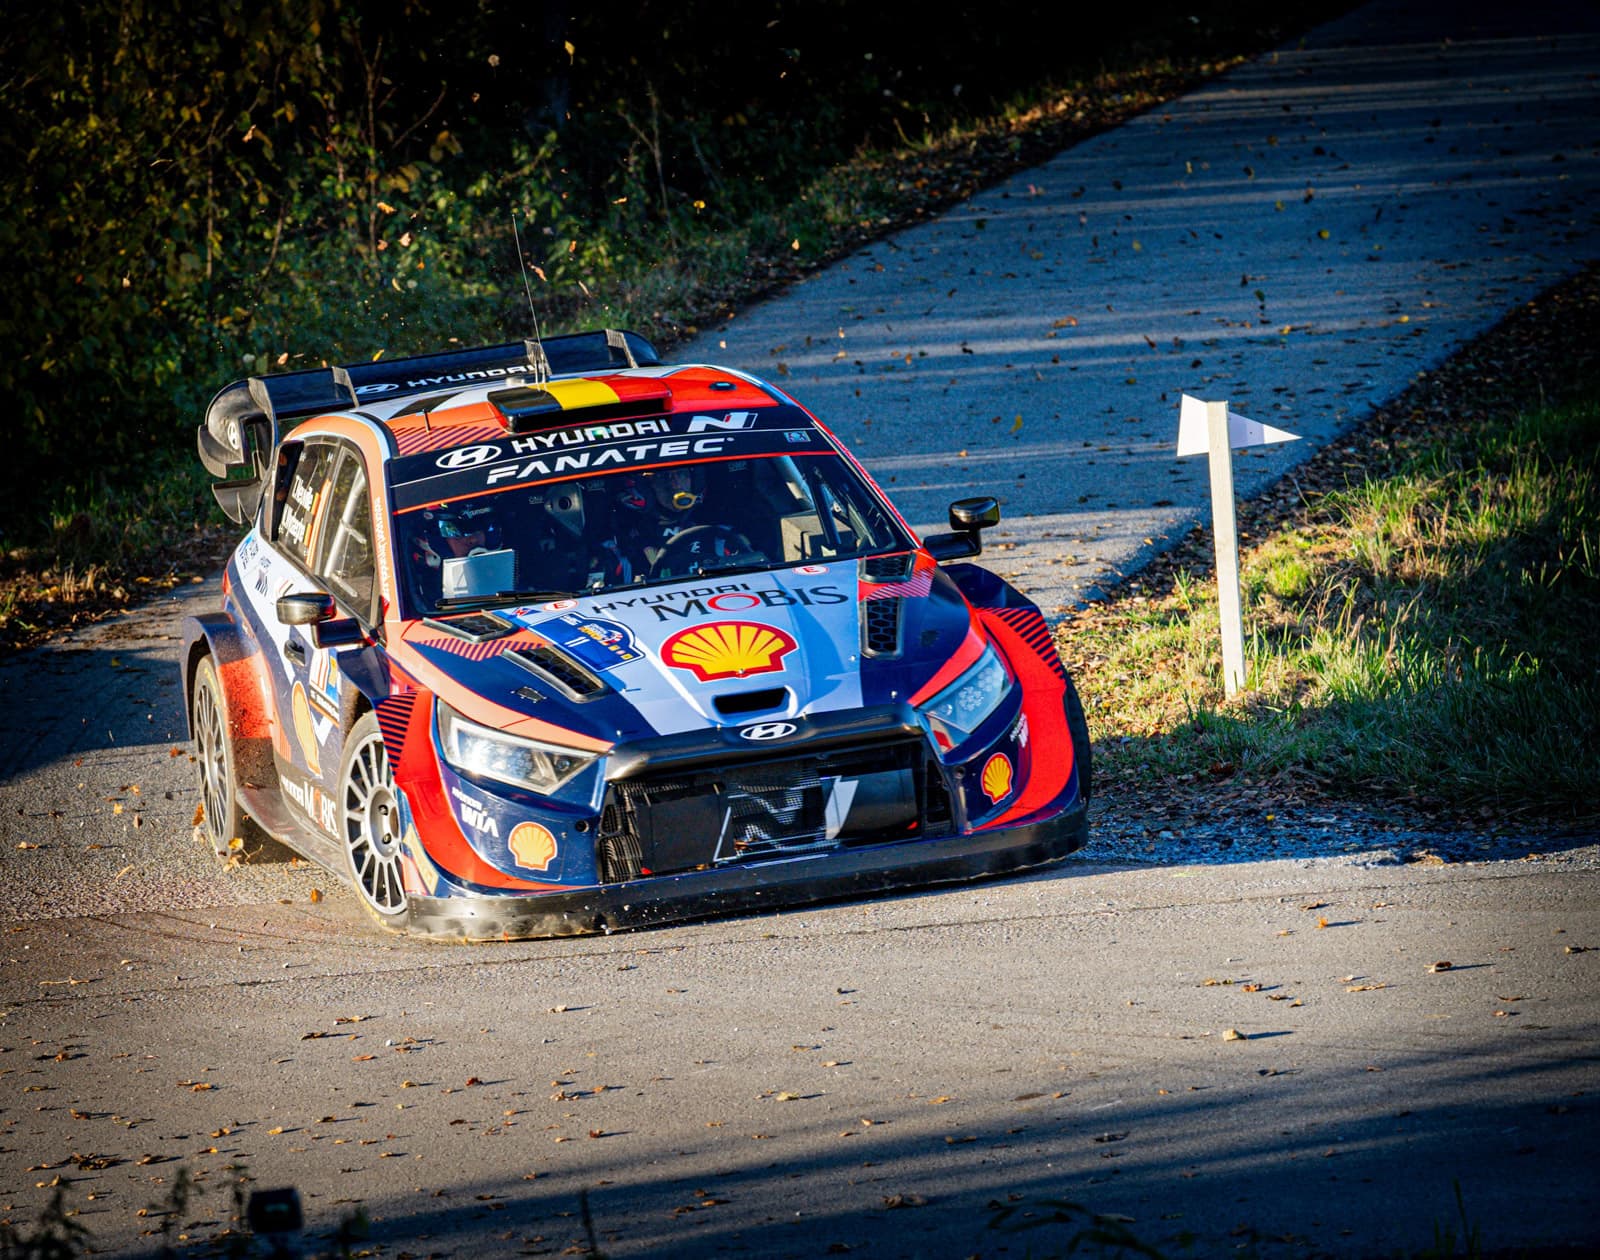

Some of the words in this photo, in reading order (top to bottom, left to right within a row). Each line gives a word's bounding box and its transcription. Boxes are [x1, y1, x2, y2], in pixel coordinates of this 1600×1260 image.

[407, 364, 537, 387] HYUNDAI
[511, 418, 671, 452] HYUNDAI
[487, 437, 725, 484] FANATEC
[592, 583, 751, 614] HYUNDAI
[651, 586, 848, 622] MOBIS
[460, 803, 499, 838] WIA
